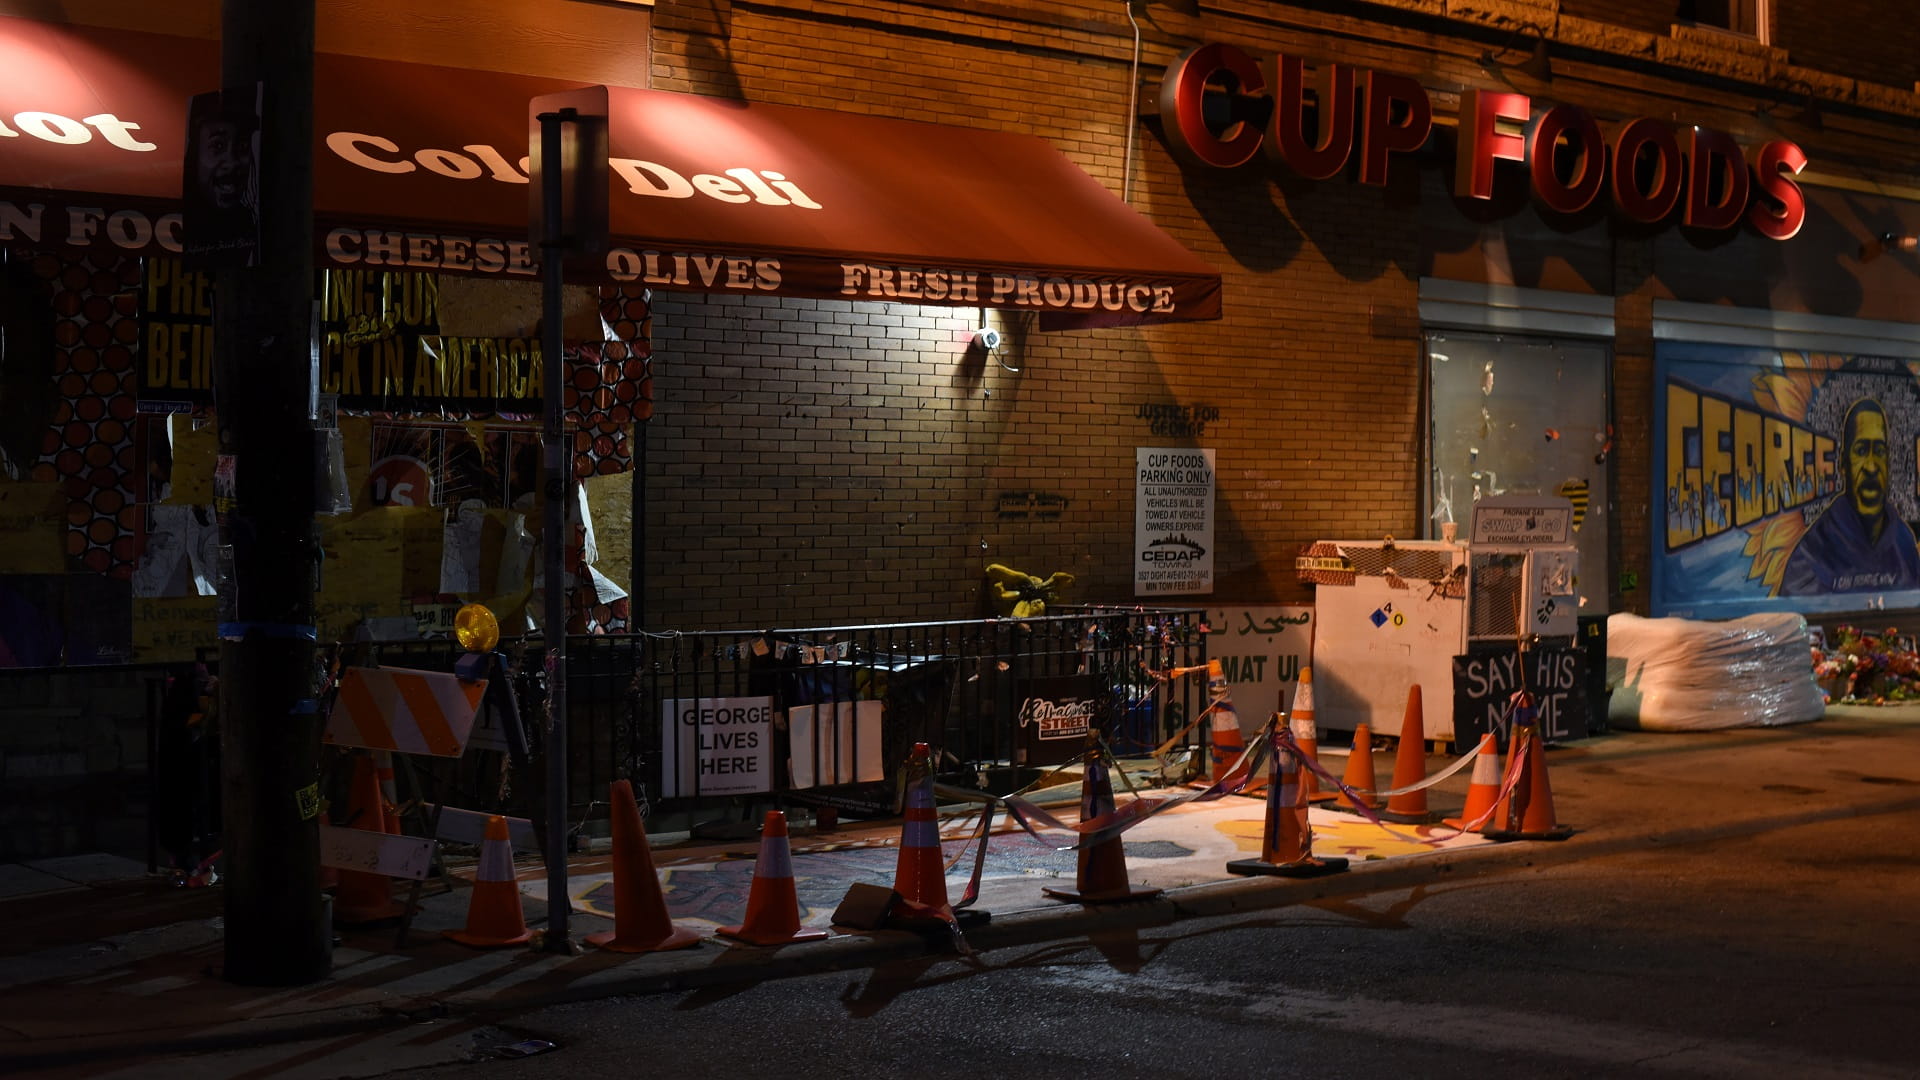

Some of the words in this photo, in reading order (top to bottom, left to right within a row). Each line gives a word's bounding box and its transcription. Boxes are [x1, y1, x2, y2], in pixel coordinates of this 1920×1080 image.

[1161, 45, 1432, 187] CUP
[1456, 89, 1808, 242] FOODS
[0, 112, 158, 152] ot
[326, 131, 530, 183] Col
[609, 157, 822, 210] Deli
[146, 257, 214, 316] PRE
[606, 247, 783, 292] OLIVES
[841, 262, 978, 304] FRESH
[990, 277, 1176, 314] PRODUCE
[1194, 405, 1220, 422] FOR
[1148, 454, 1169, 468] CUP
[1171, 455, 1204, 468] FOODS
[1666, 385, 1838, 550] GEORGE
[1140, 470, 1184, 483] PARKING
[1186, 471, 1211, 484] ONLY
[1144, 487, 1157, 496] ALL
[1158, 487, 1208, 497] UNAUTHORIZED
[1146, 498, 1178, 508] VEHICLES
[1179, 499, 1194, 508] WILL
[1196, 499, 1205, 508] BE
[1145, 510, 1169, 520] TOWED
[1169, 510, 1178, 520] AT
[1179, 510, 1206, 520] VEHICLE
[1145, 521, 1174, 531] OWNERS
[1175, 522, 1205, 531] EXPENSE
[1482, 519, 1521, 533] SWAP
[1541, 519, 1562, 532] GO
[1488, 535, 1520, 544] EXCHANGE
[1142, 551, 1202, 562] CEDAR
[1152, 561, 1193, 569] TOWING
[1145, 583, 1158, 592] MIN
[1159, 582, 1173, 592] TOW
[1174, 581, 1186, 591] FEE
[1383, 602, 1393, 613] 4
[1467, 651, 1517, 698] SAY
[1536, 651, 1575, 689] HIS
[683, 707, 770, 726] GEORGE
[1040, 716, 1089, 729] STREET
[1487, 693, 1568, 742] NME
[700, 731, 758, 750] LIVES
[701, 756, 757, 775] HERE
